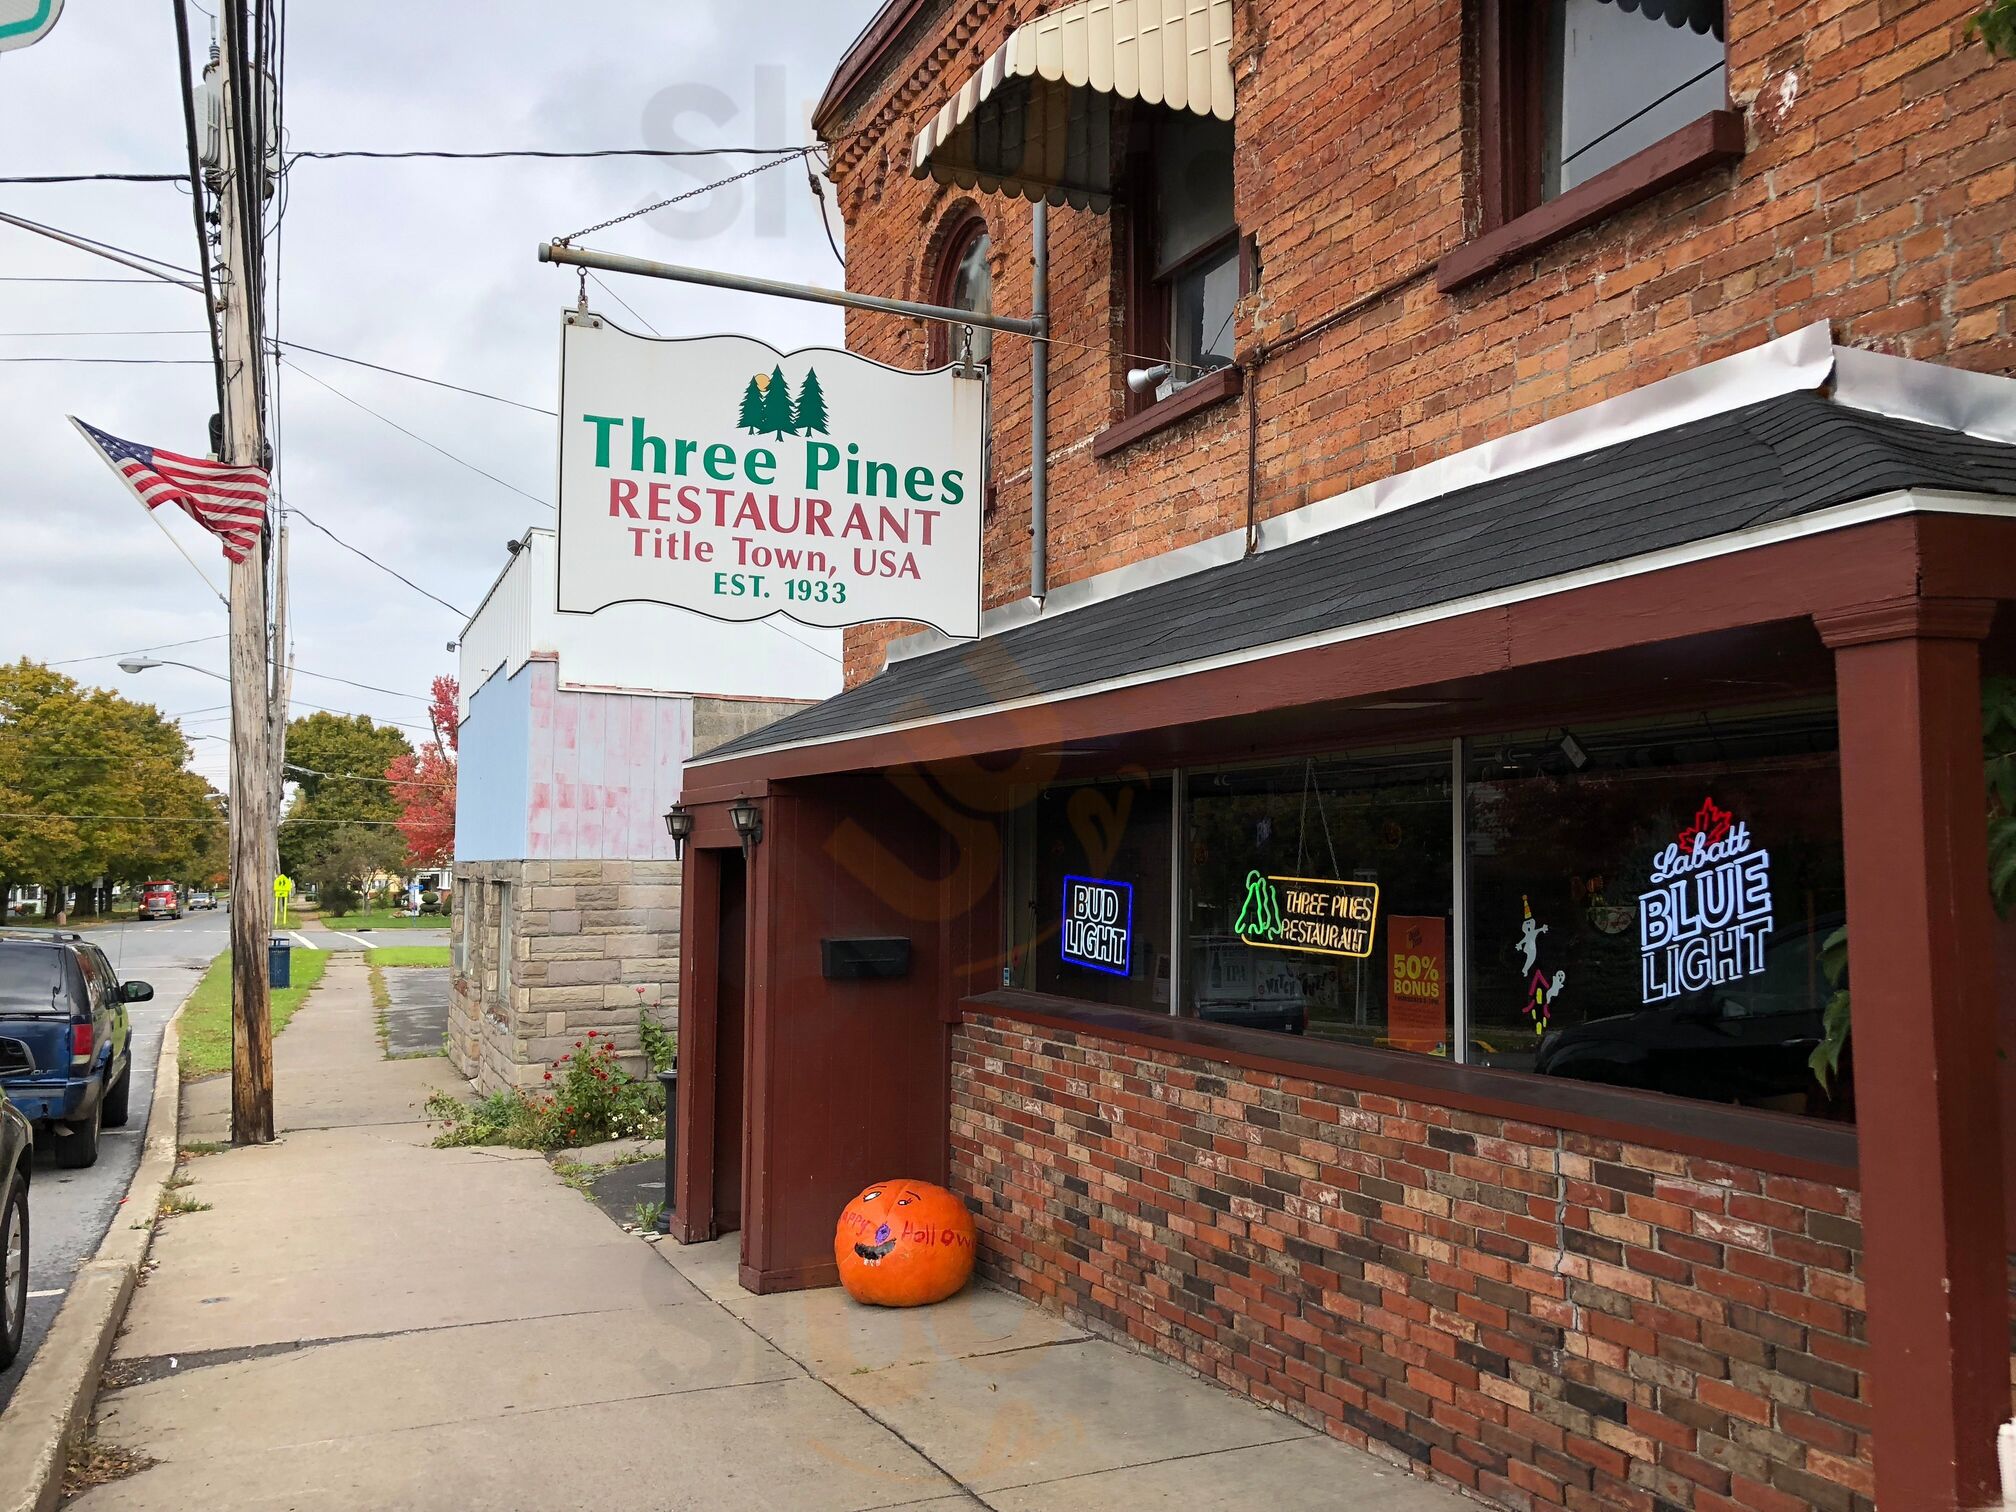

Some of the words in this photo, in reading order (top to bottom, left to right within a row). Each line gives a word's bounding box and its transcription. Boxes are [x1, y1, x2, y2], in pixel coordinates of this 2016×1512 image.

[583, 414, 777, 486] Three
[805, 440, 965, 506] Pines
[608, 477, 941, 547] RESTAURANT
[627, 526, 714, 563] Title
[731, 536, 838, 579] Town,
[852, 547, 921, 580] USA
[713, 571, 770, 599] EST.
[784, 578, 847, 605] 1933
[1650, 820, 1751, 884] Labatt
[1074, 884, 1119, 925] BUD
[1286, 890, 1330, 916] THREE
[1331, 895, 1373, 922] PINES
[1638, 849, 1772, 952] BLUE
[1280, 918, 1368, 953] RESTAURANT
[1393, 953, 1440, 981] 50%
[1641, 914, 1774, 1005] LIGHT
[1393, 979, 1440, 998] BONUS
